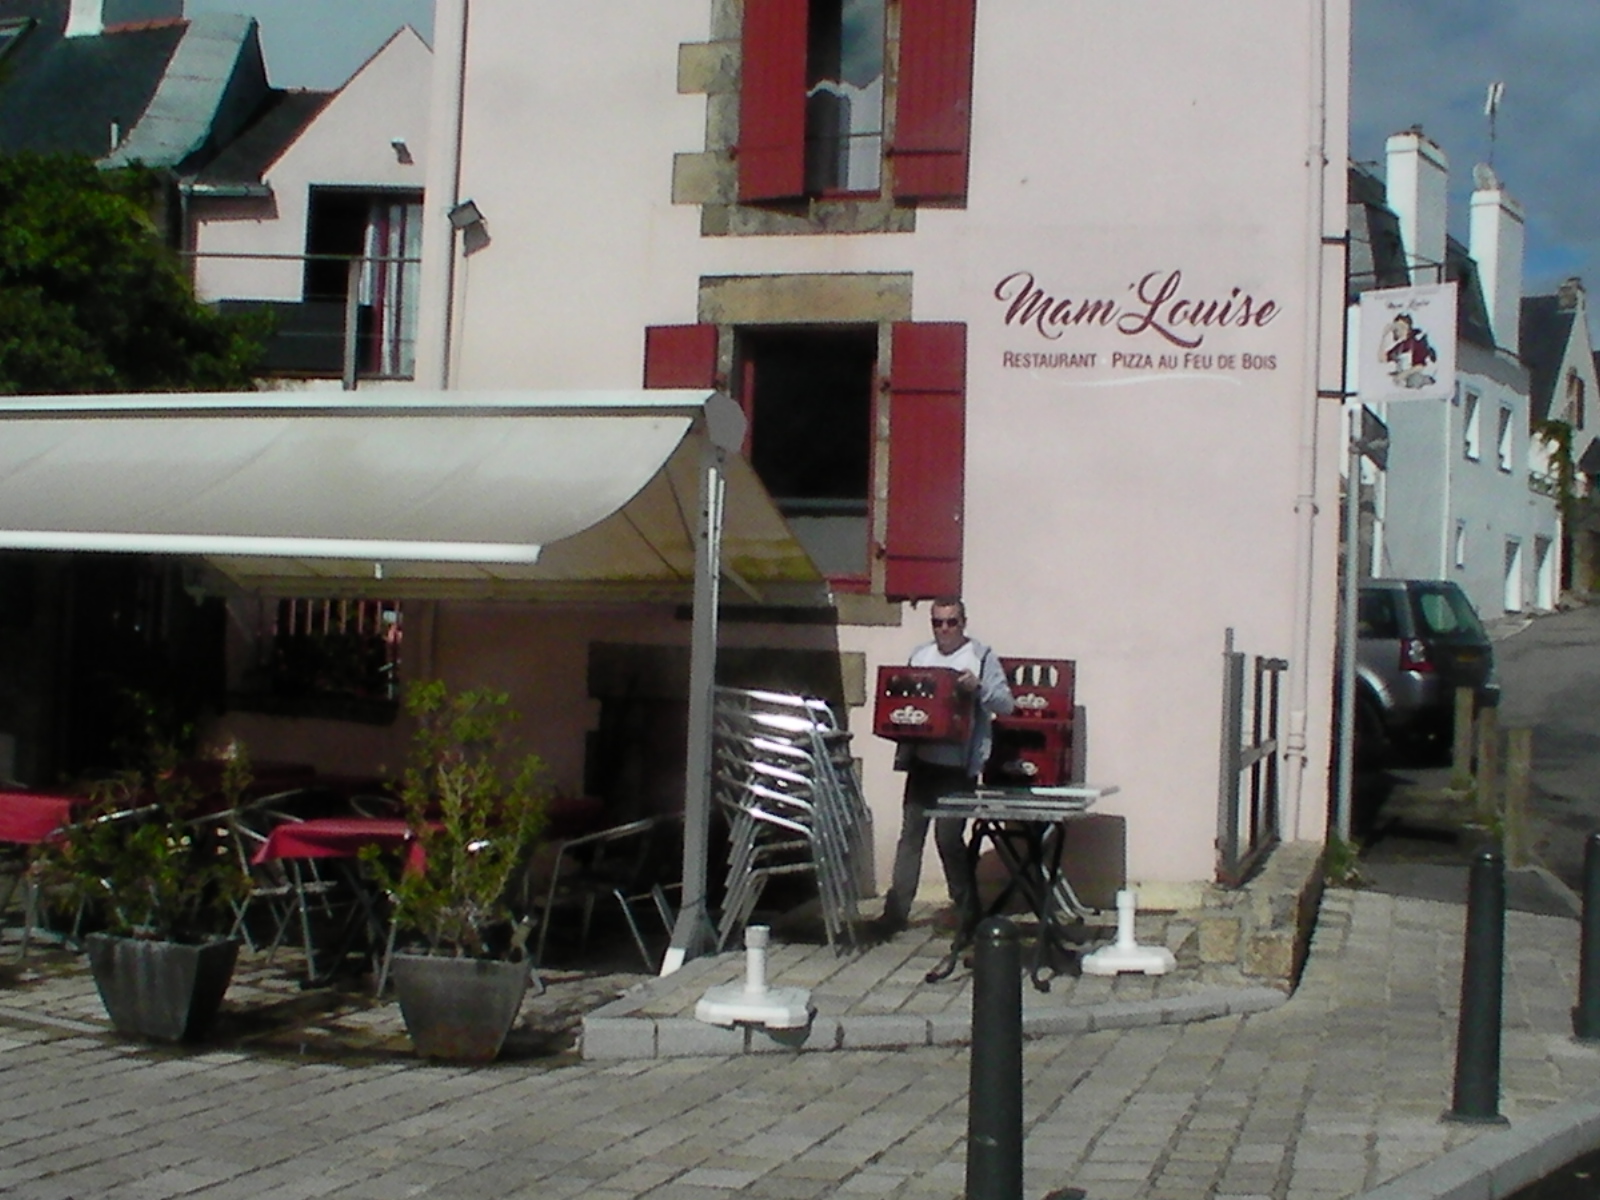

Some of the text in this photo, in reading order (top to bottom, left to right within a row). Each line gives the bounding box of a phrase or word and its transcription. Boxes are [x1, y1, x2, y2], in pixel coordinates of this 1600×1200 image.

[1002, 351, 1277, 370] RESTAURANT PIZZA AU FEU DE BOIS
